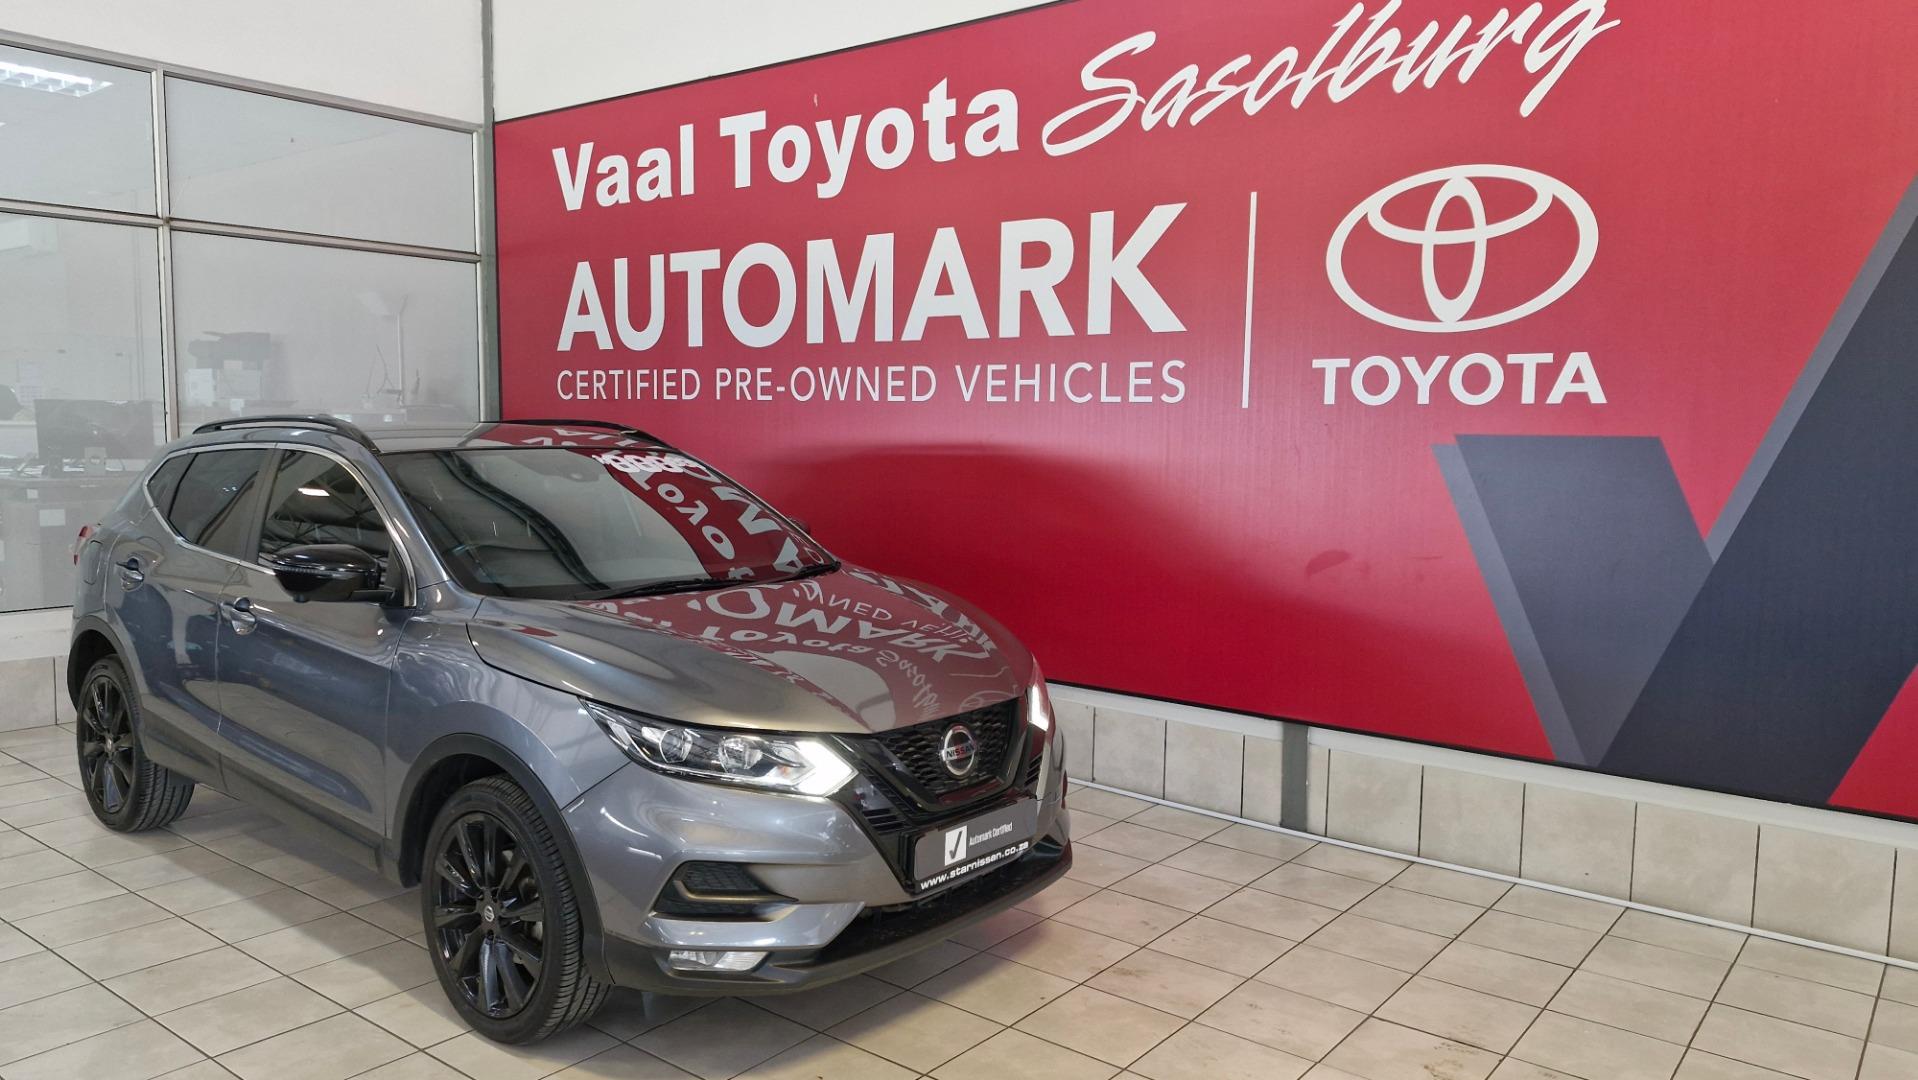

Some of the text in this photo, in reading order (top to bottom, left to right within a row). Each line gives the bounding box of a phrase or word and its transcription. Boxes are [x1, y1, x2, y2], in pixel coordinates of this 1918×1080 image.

[553, 0, 1620, 211] Vaal Toyota Sasolburg
[557, 203, 1187, 352] AUTOMARK
[557, 359, 1187, 404] CERTIFIED PRE-OWNED VEHICLES
[1312, 352, 1607, 407] TOYOTA
